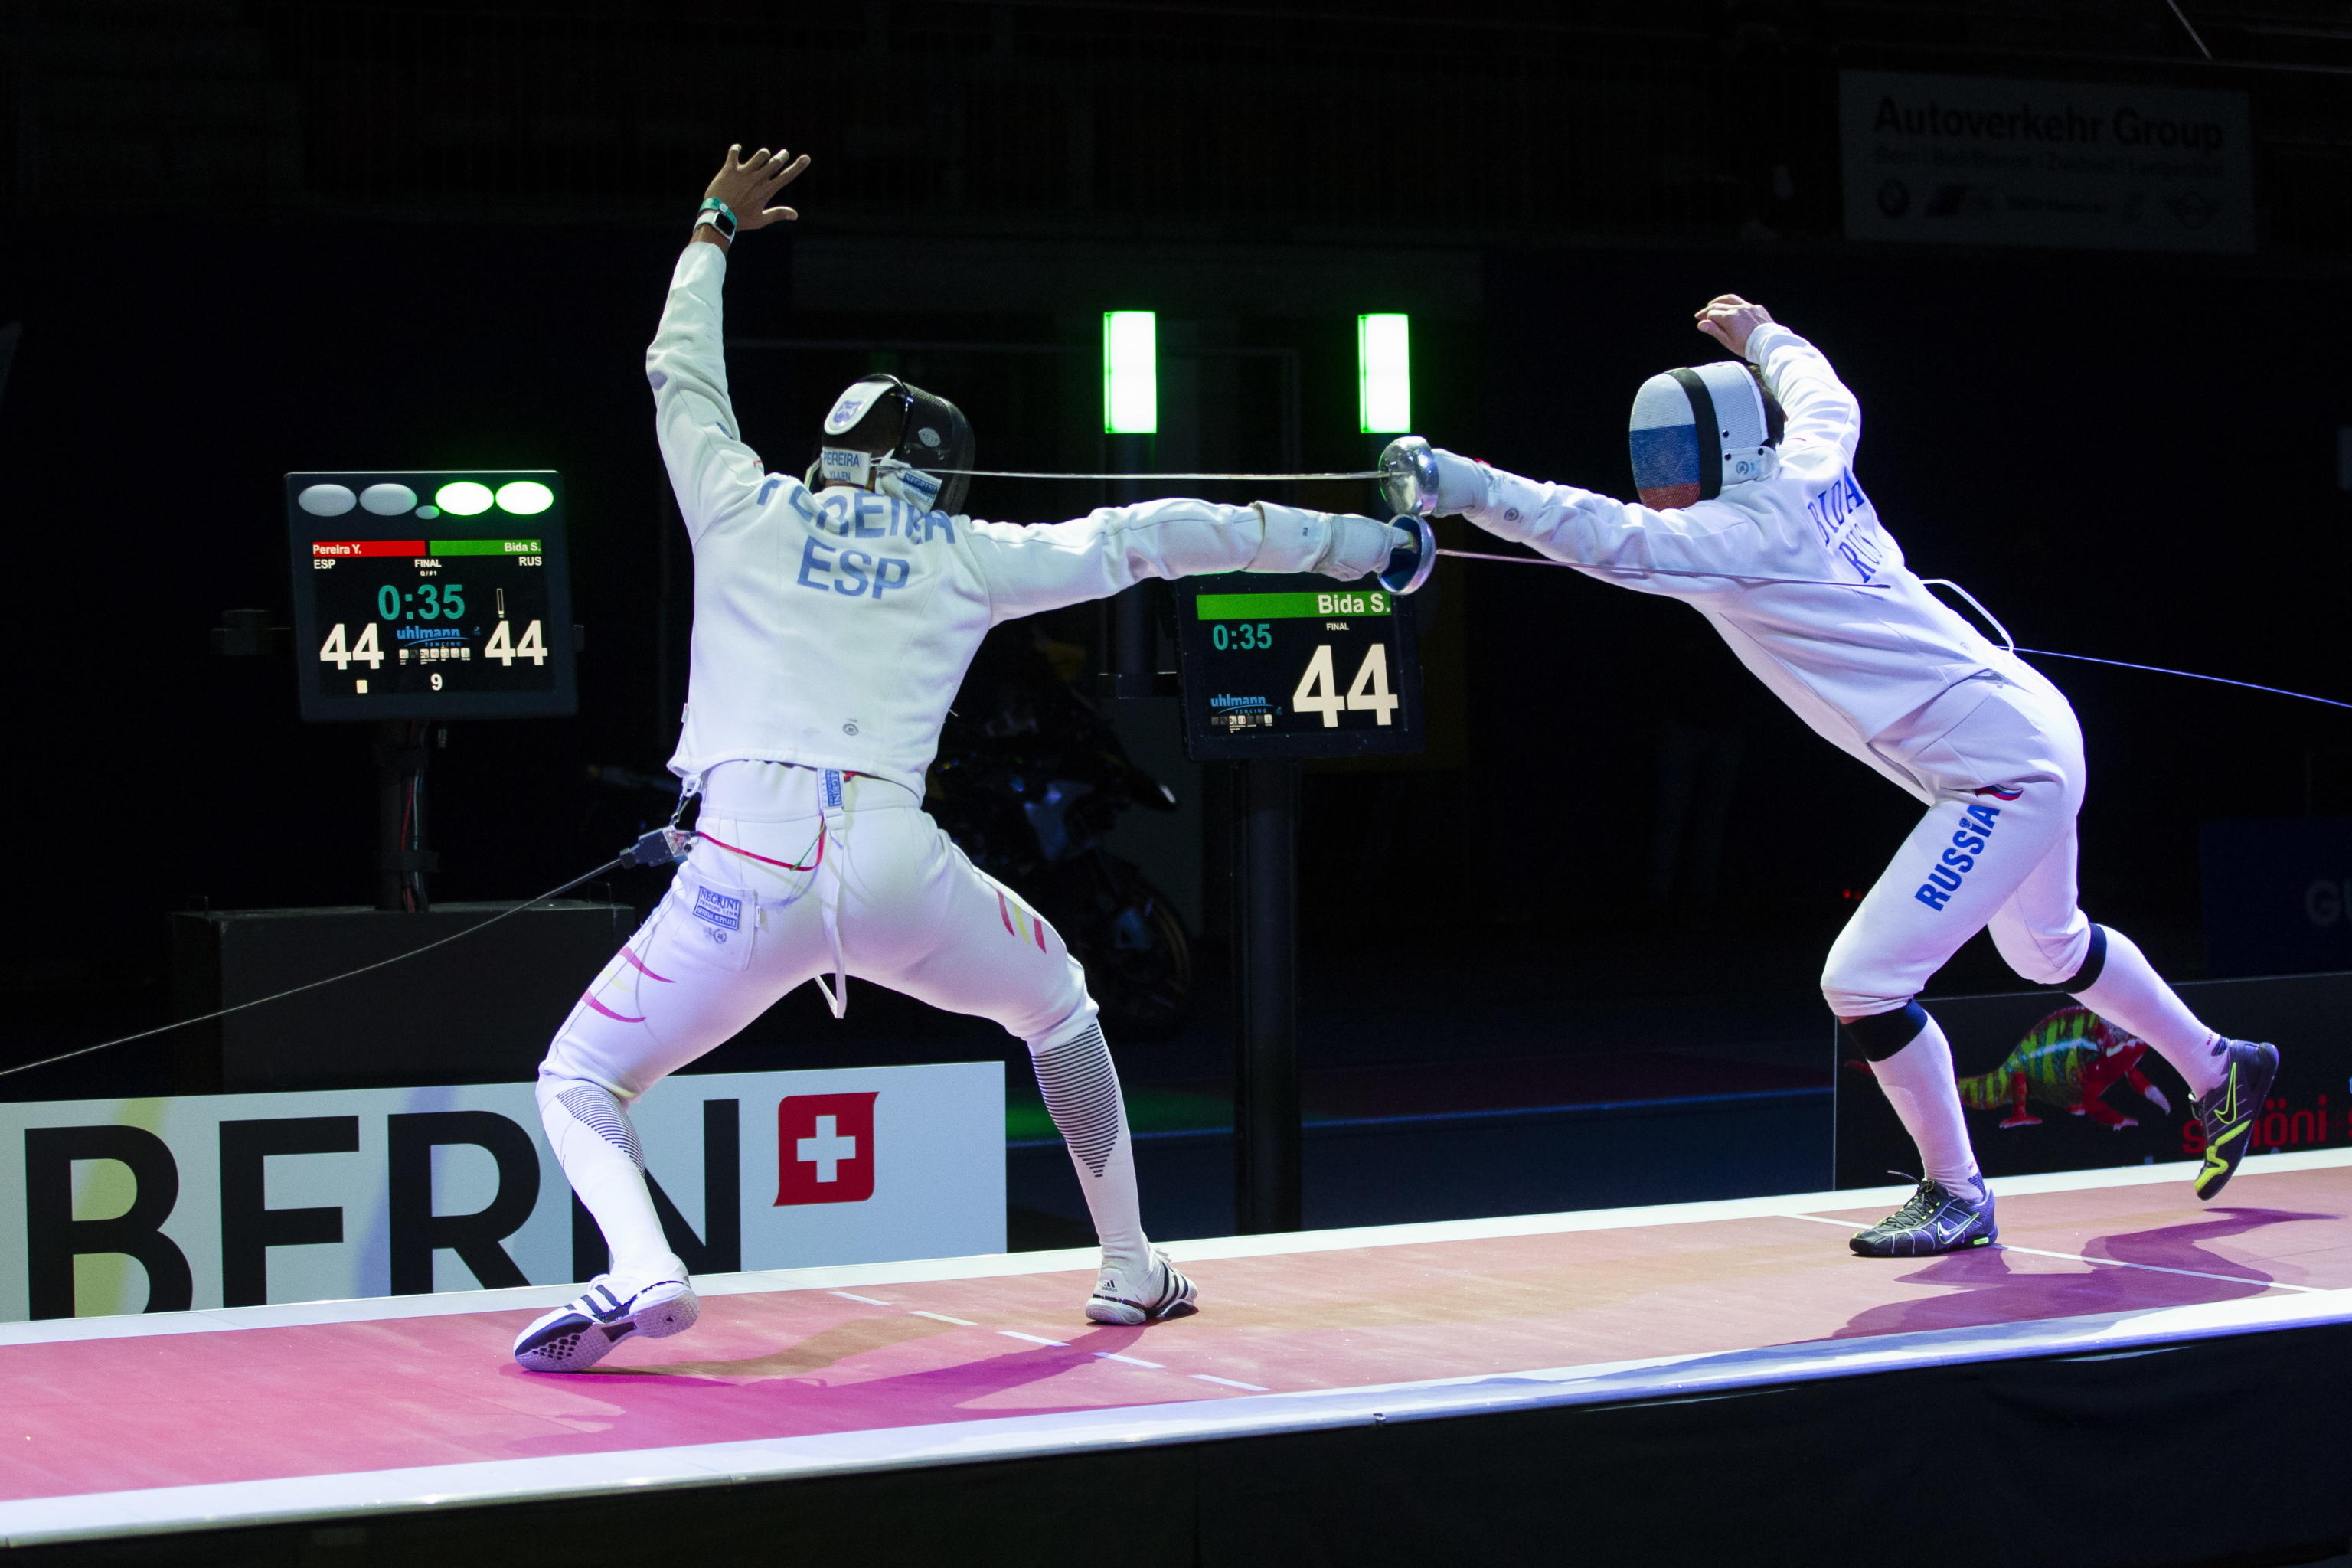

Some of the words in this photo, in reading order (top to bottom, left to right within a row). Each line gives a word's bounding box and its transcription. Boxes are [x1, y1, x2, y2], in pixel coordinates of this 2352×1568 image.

[1874, 95, 2104, 143] Autoverkehr
[2112, 106, 2223, 157] Group
[824, 452, 860, 467] PEREIRA
[312, 544, 351, 554] Pereira
[351, 544, 362, 554] Y.
[504, 542, 528, 552] Bida
[530, 541, 541, 552] S.
[314, 558, 336, 570] ESP
[414, 558, 442, 567] FINAL
[518, 556, 543, 567] RUS
[797, 534, 910, 600] ESP
[377, 583, 466, 621] 0:35
[1318, 593, 1364, 614] Bida
[1370, 593, 1391, 612] S.
[396, 625, 460, 640] uhlmann
[1326, 622, 1350, 631] FINAL
[484, 619, 548, 667] 44
[1212, 623, 1273, 650] 0:35
[319, 622, 385, 671] 44
[430, 673, 443, 691] 9
[1292, 643, 1400, 728] 44
[1210, 694, 1266, 707] uhlmann
[701, 888, 738, 911] NEGRINI
[25, 1098, 742, 1321] BERN
